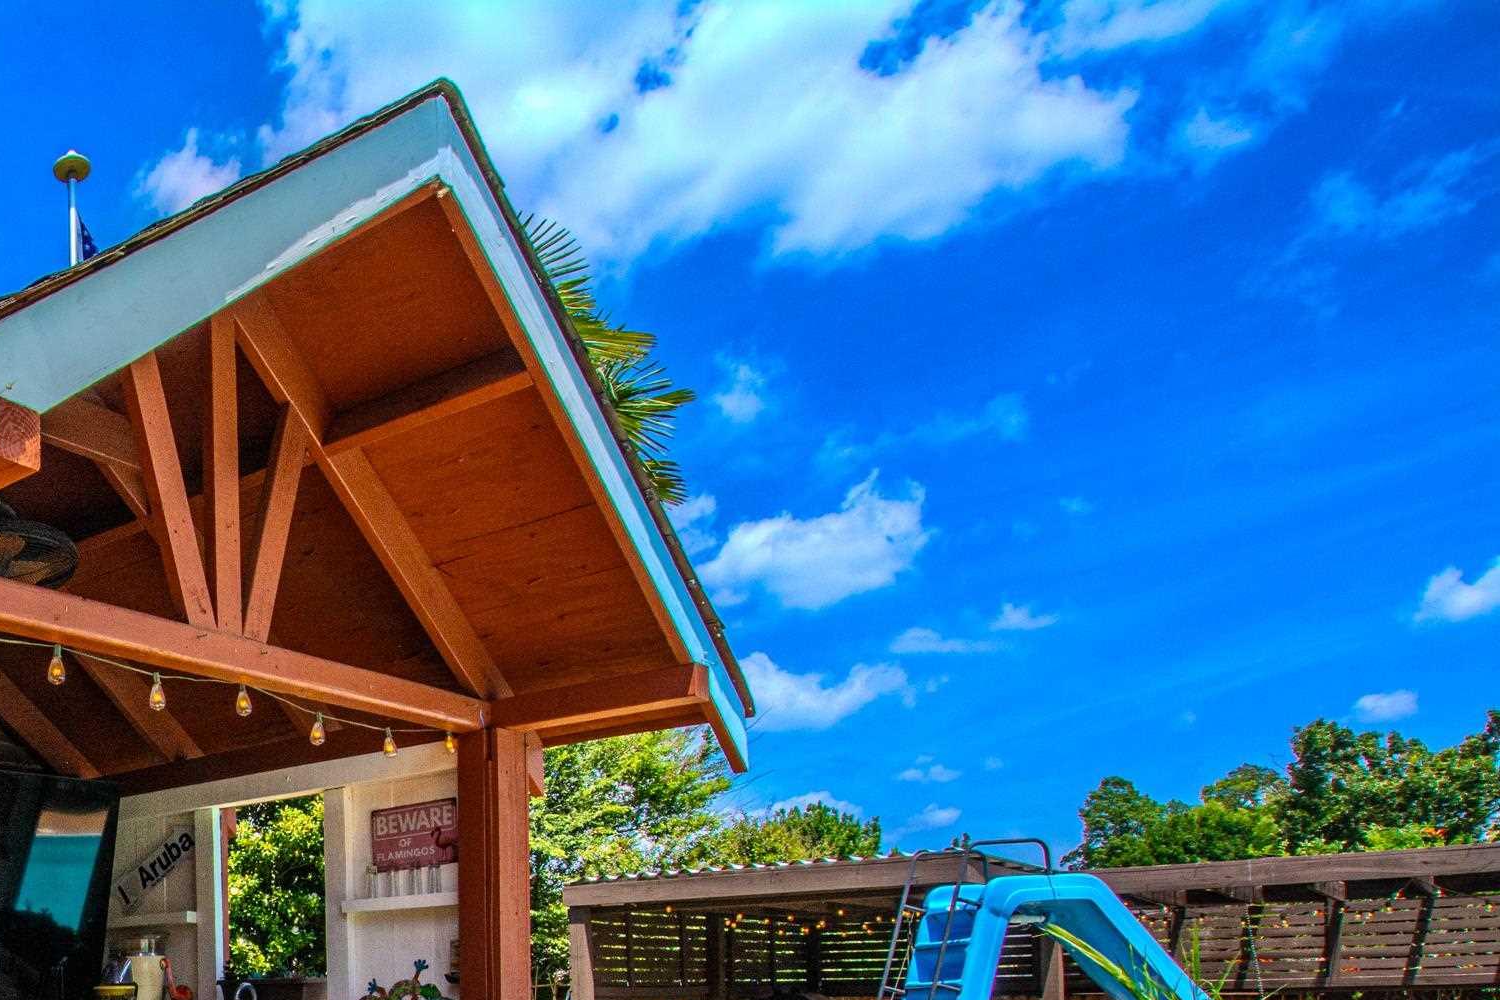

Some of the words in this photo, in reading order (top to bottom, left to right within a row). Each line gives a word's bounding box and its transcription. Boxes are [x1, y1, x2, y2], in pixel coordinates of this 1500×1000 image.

[376, 804, 453, 835] BEWARE
[376, 847, 436, 862] FLAMINGOS
[398, 838, 412, 848] OF
[138, 832, 196, 890] Aruba
